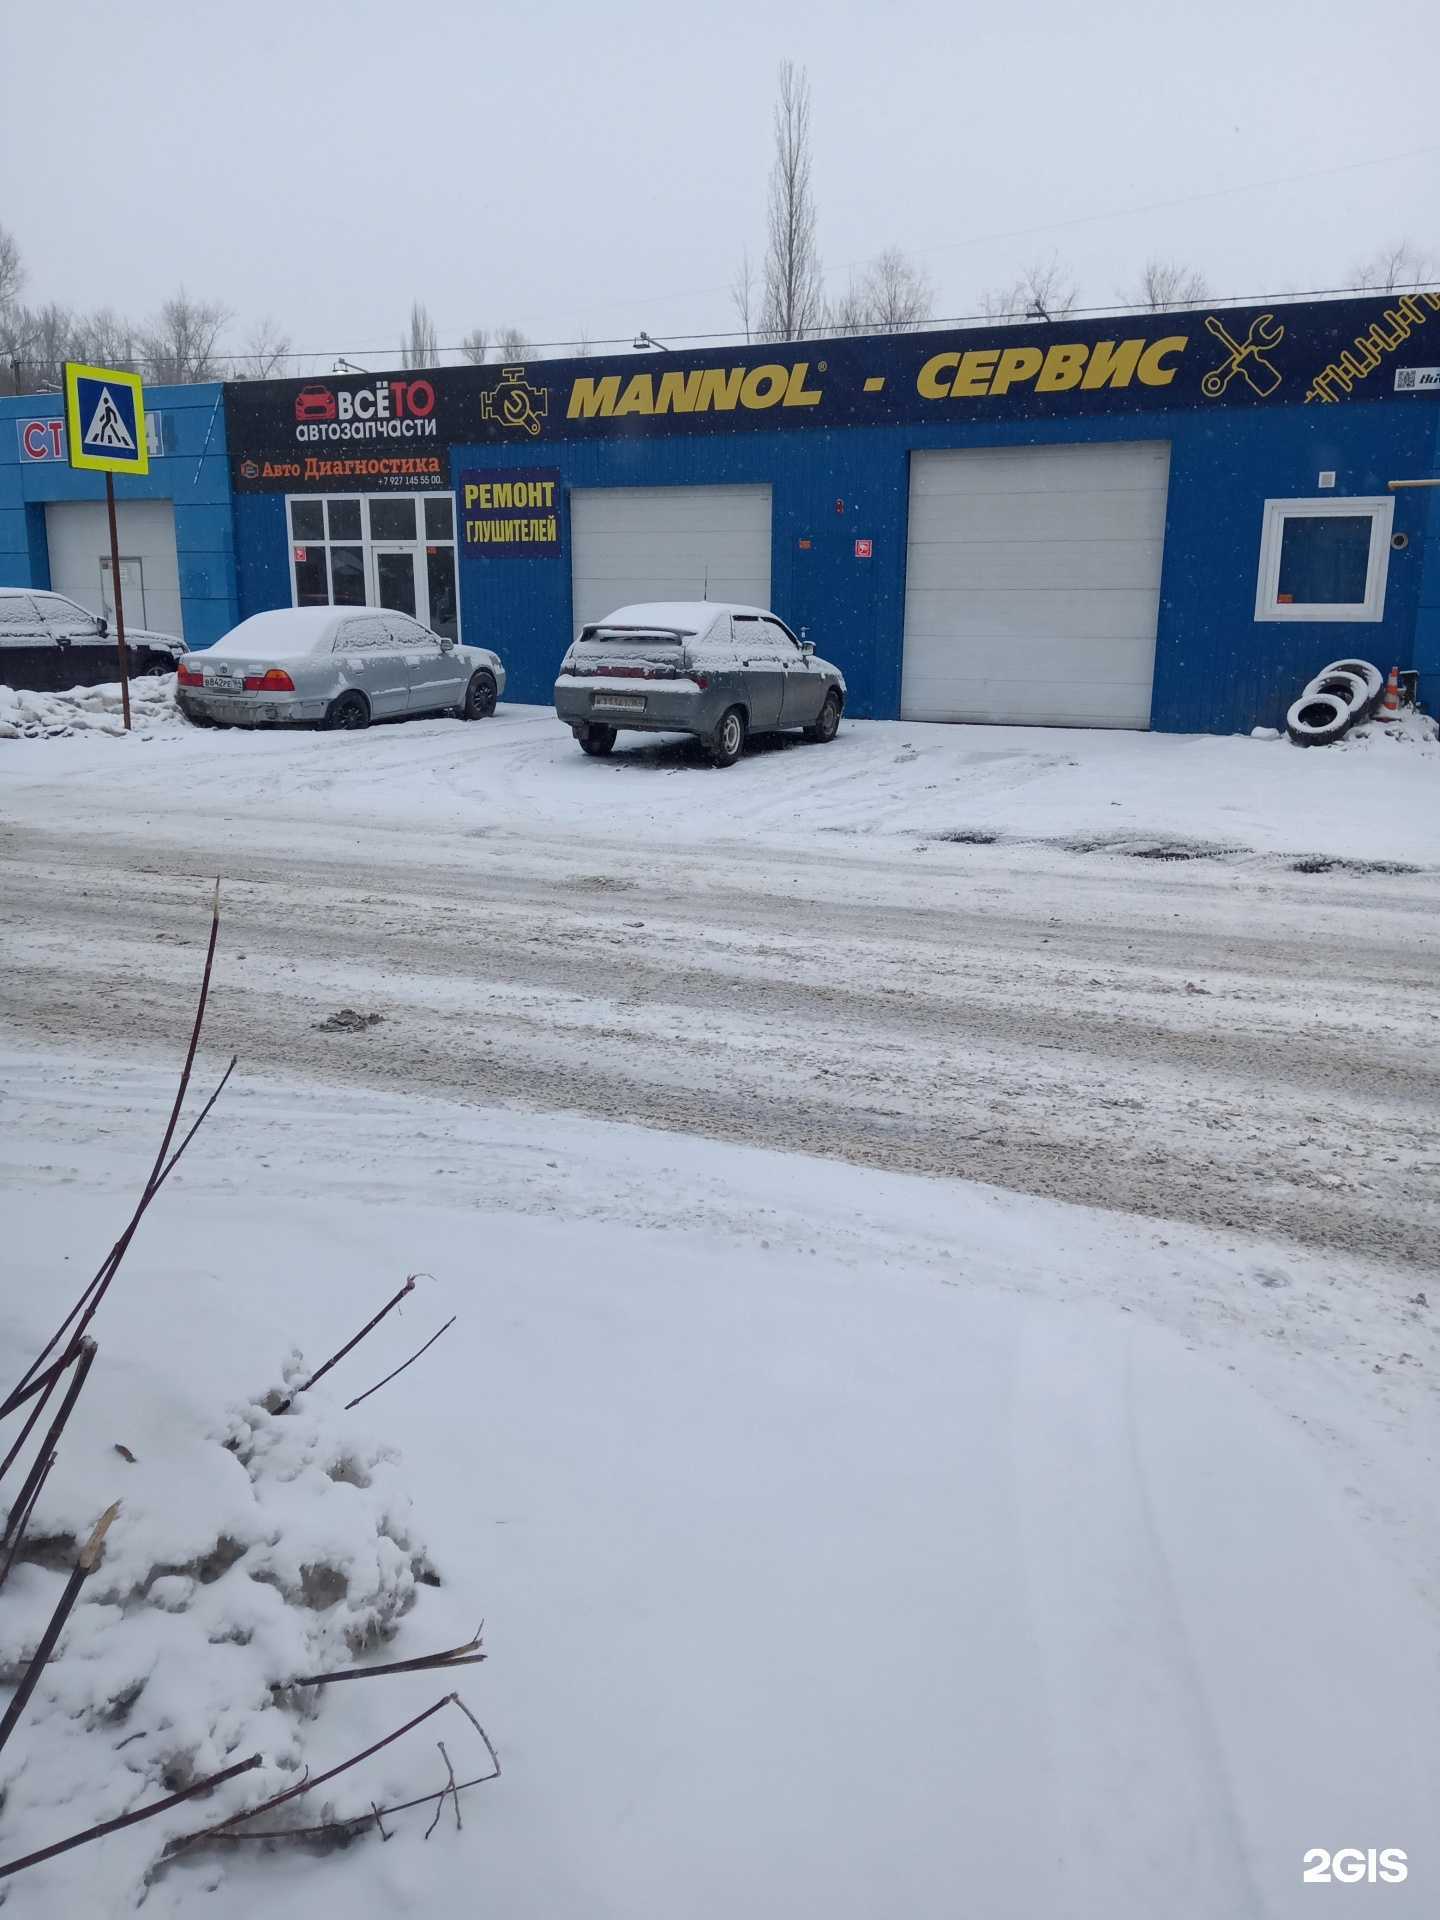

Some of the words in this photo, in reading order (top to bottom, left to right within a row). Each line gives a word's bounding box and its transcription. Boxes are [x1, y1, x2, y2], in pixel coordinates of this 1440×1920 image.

[916, 336, 1189, 400] СЕРВИС
[23, 420, 65, 460] СТ
[296, 417, 437, 442] автозапчасти
[262, 461, 301, 478] Авто
[304, 456, 441, 481] Диагностика
[389, 476, 403, 486] 927
[405, 475, 419, 486] 145
[420, 475, 430, 485] 55
[464, 482, 555, 509] РЕМОНТ
[466, 515, 557, 543] ГЛУШИТЕЛЕЙ
